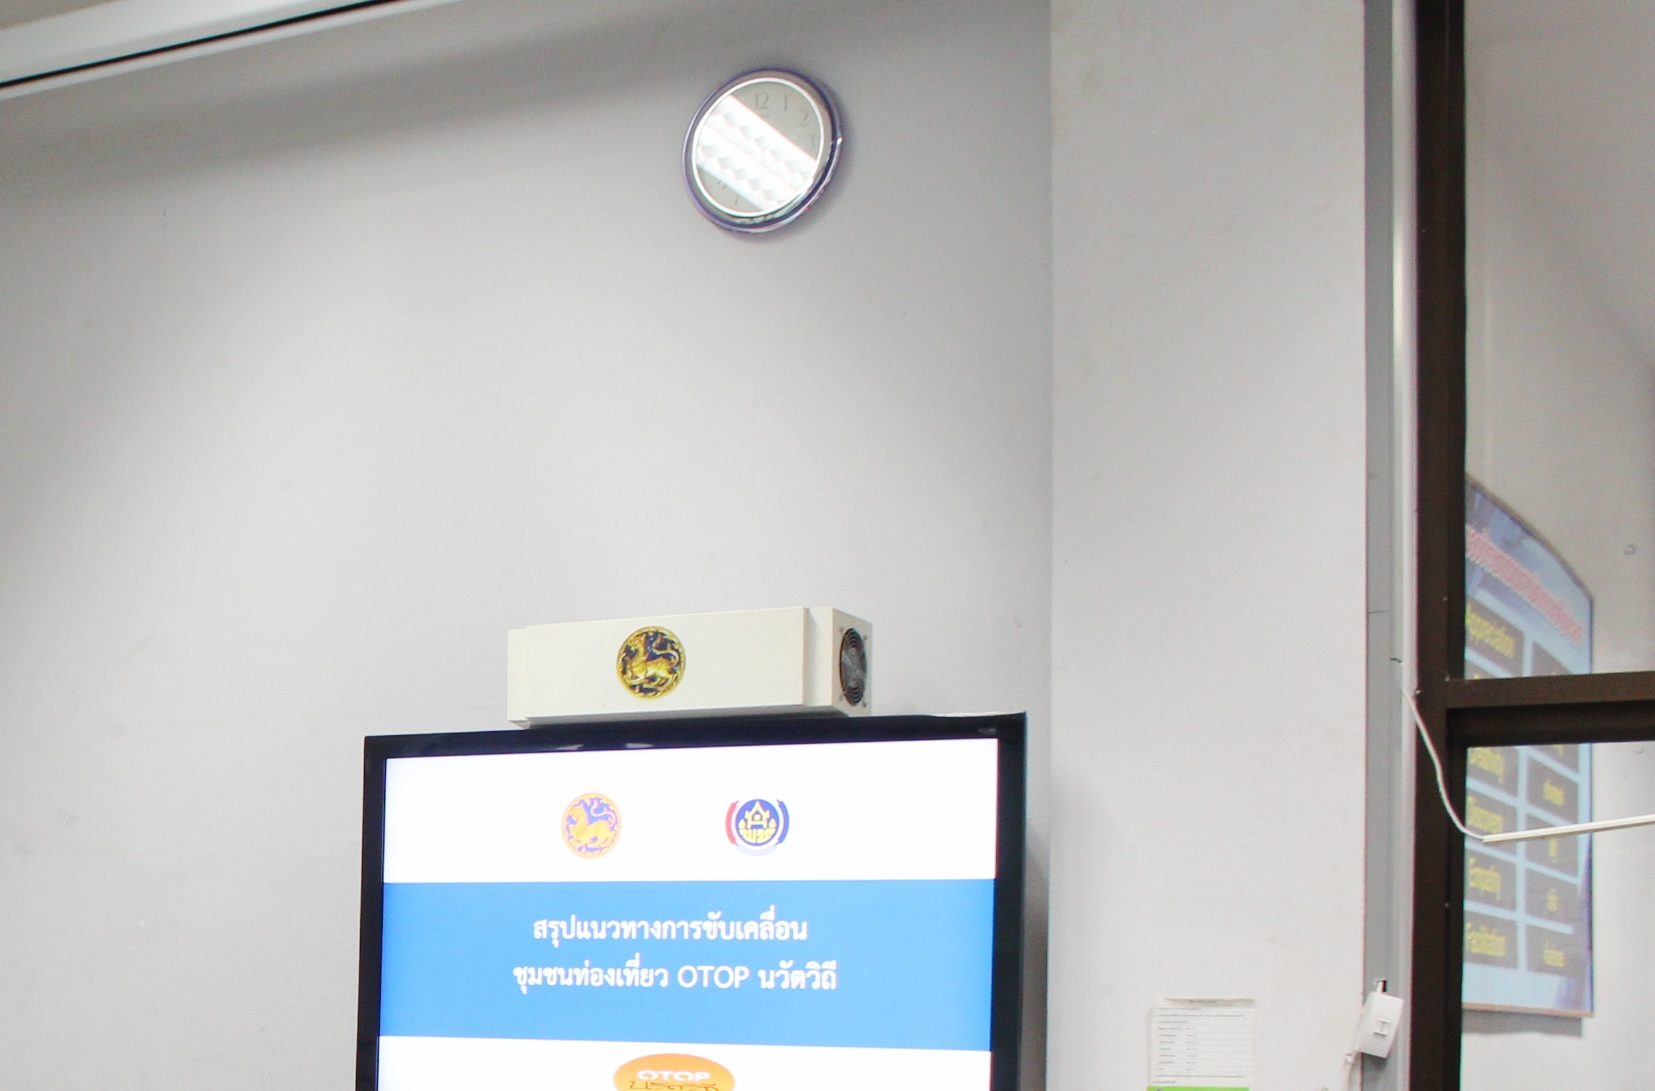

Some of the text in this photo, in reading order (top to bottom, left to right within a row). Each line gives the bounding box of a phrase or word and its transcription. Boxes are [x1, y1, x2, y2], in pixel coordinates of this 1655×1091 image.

[532, 904, 808, 949] สรุปแนวทางการขับเคลื่อน
[512, 951, 837, 995] ชุมชนท่องเที่ยว OTOP นวัตวิถี
[636, 1069, 712, 1082] OTOP
